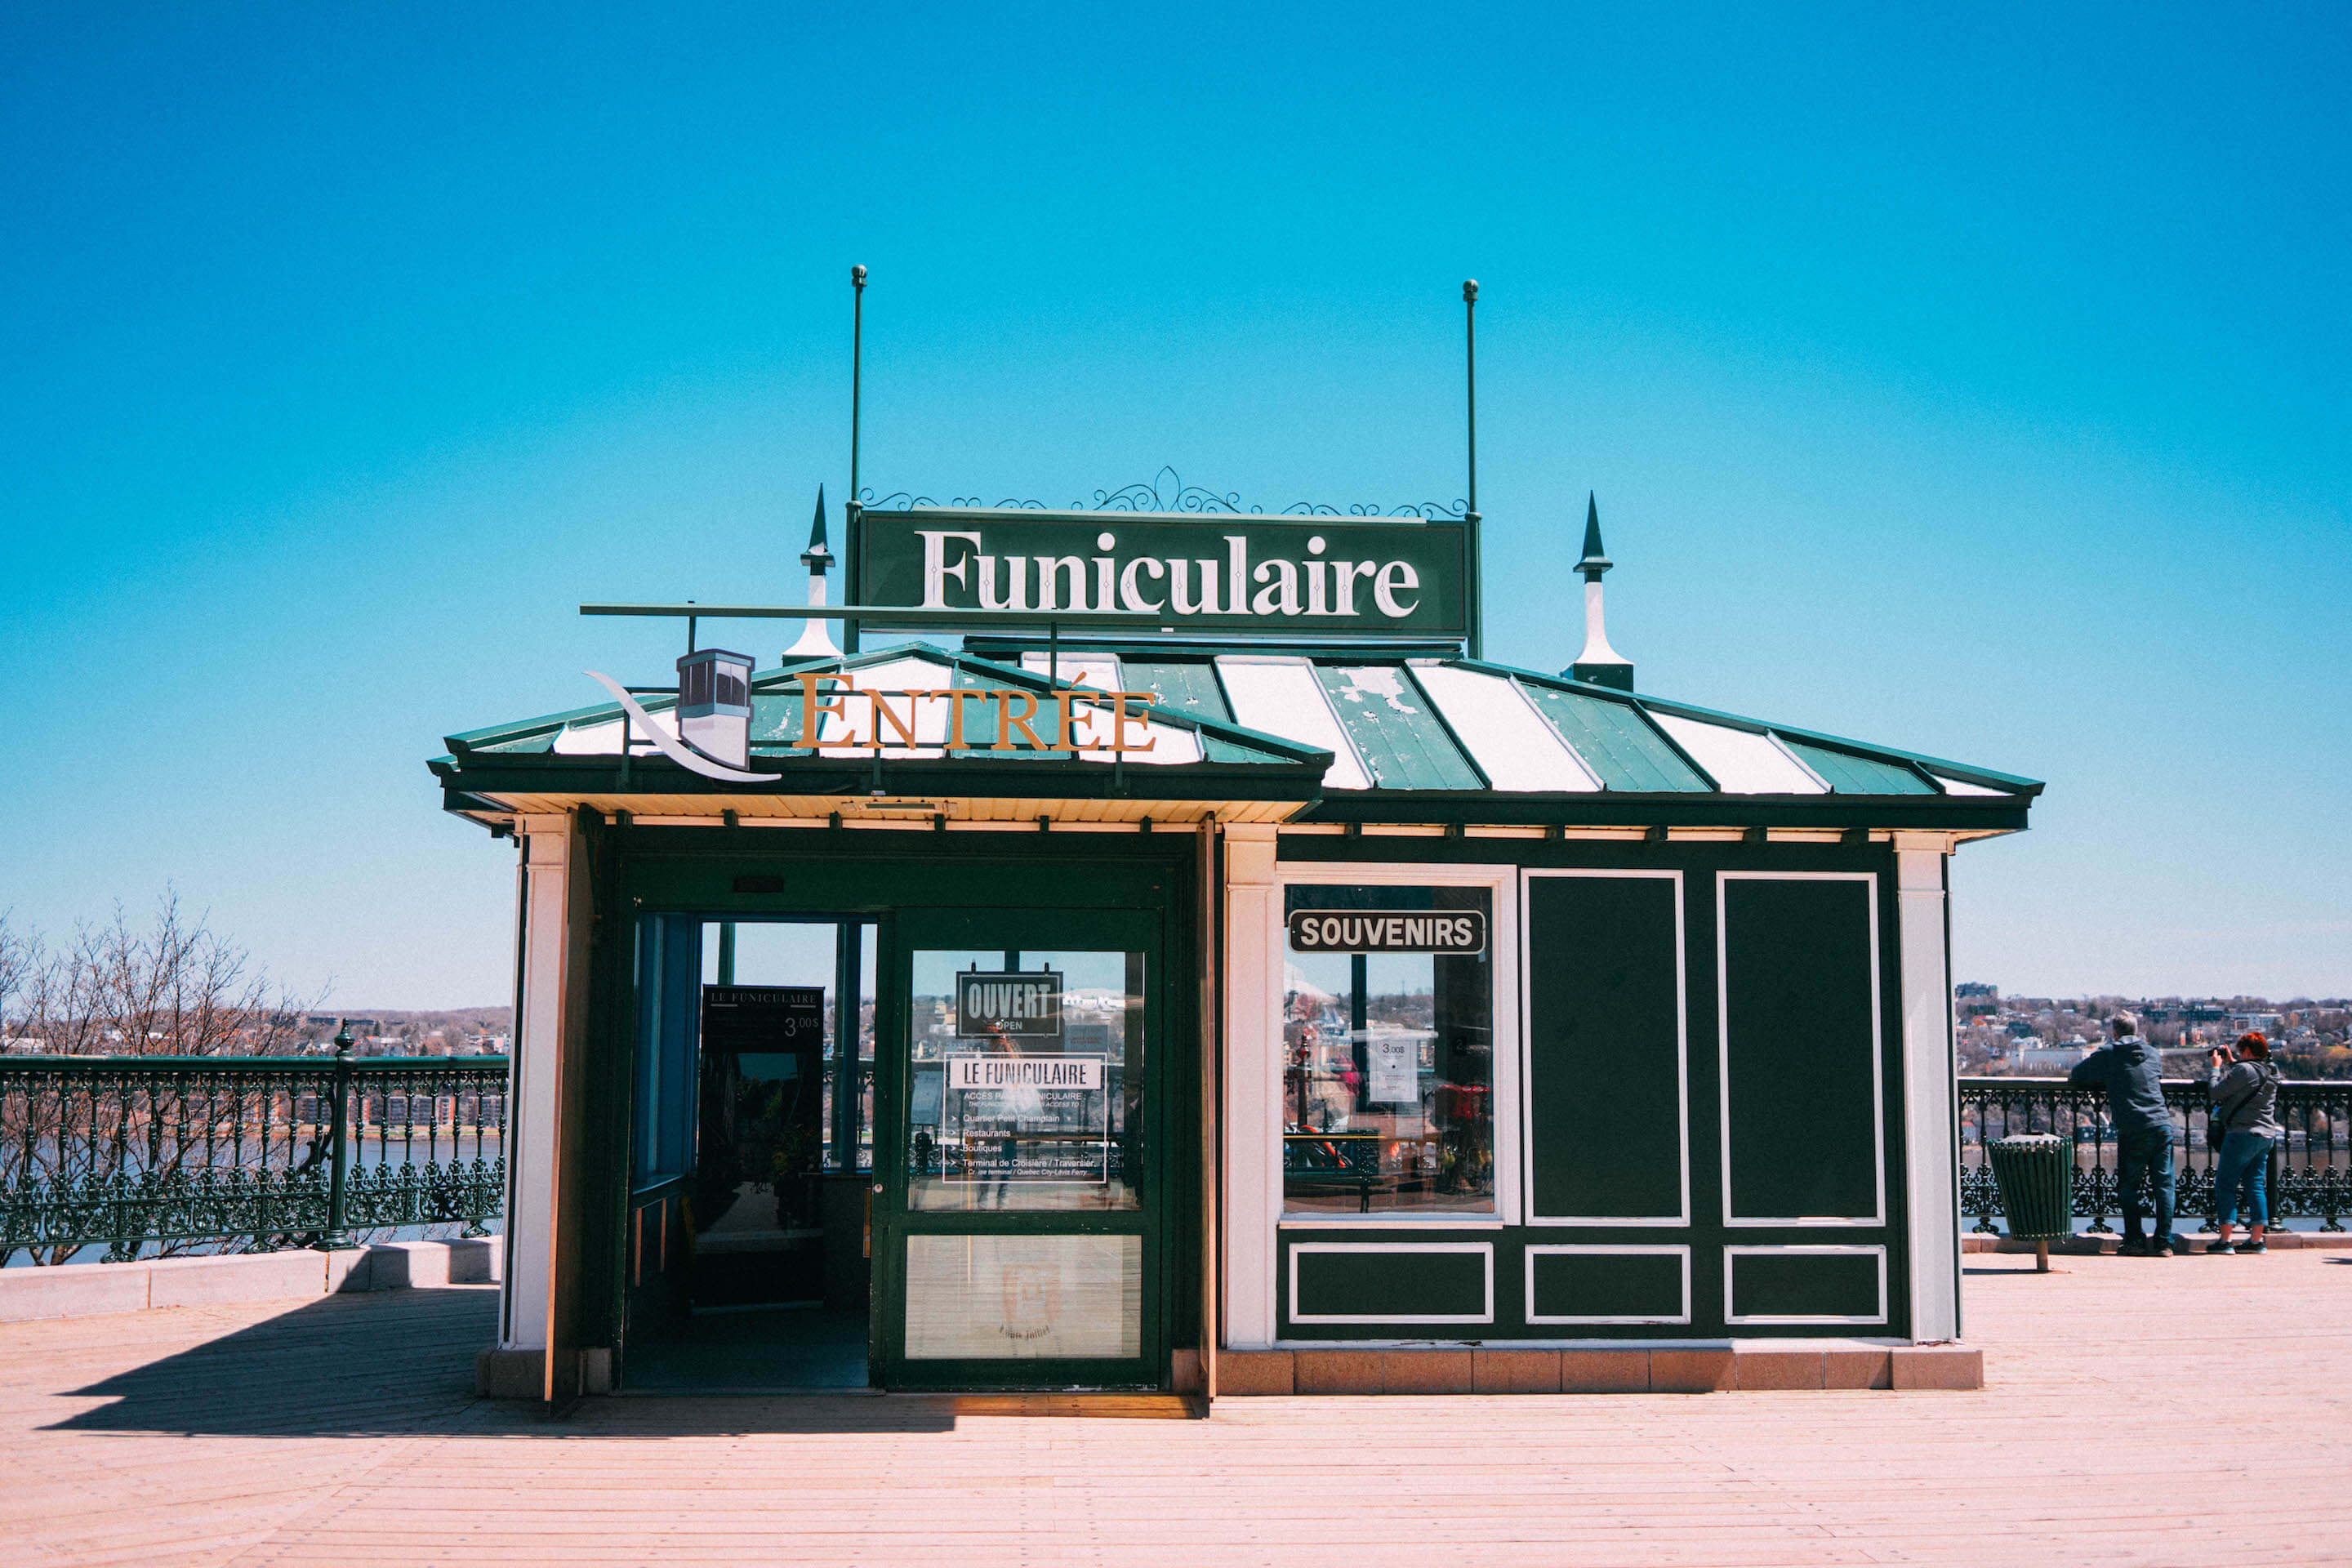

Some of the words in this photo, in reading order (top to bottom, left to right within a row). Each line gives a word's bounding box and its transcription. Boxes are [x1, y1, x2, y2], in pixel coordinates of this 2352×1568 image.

[914, 530, 1419, 618] Funiculaire
[792, 671, 1156, 751] ENTRÉE
[1300, 917, 1473, 946] SOUVENIRS
[711, 992, 726, 1002] LE
[732, 992, 817, 1004] FUNICULAIRE
[968, 982, 1051, 1019] OUVERT
[995, 1021, 1022, 1030] OPEN
[964, 1062, 980, 1085] LE
[986, 1062, 1087, 1085] FUNICULAIRE
[963, 1114, 996, 1123] Quartier
[997, 1114, 1016, 1122] Petit
[1017, 1114, 1060, 1124] Champlain
[963, 1129, 1011, 1138] Restaurants
[963, 1144, 1002, 1154] Boutiques
[964, 1159, 997, 1168] Terminal
